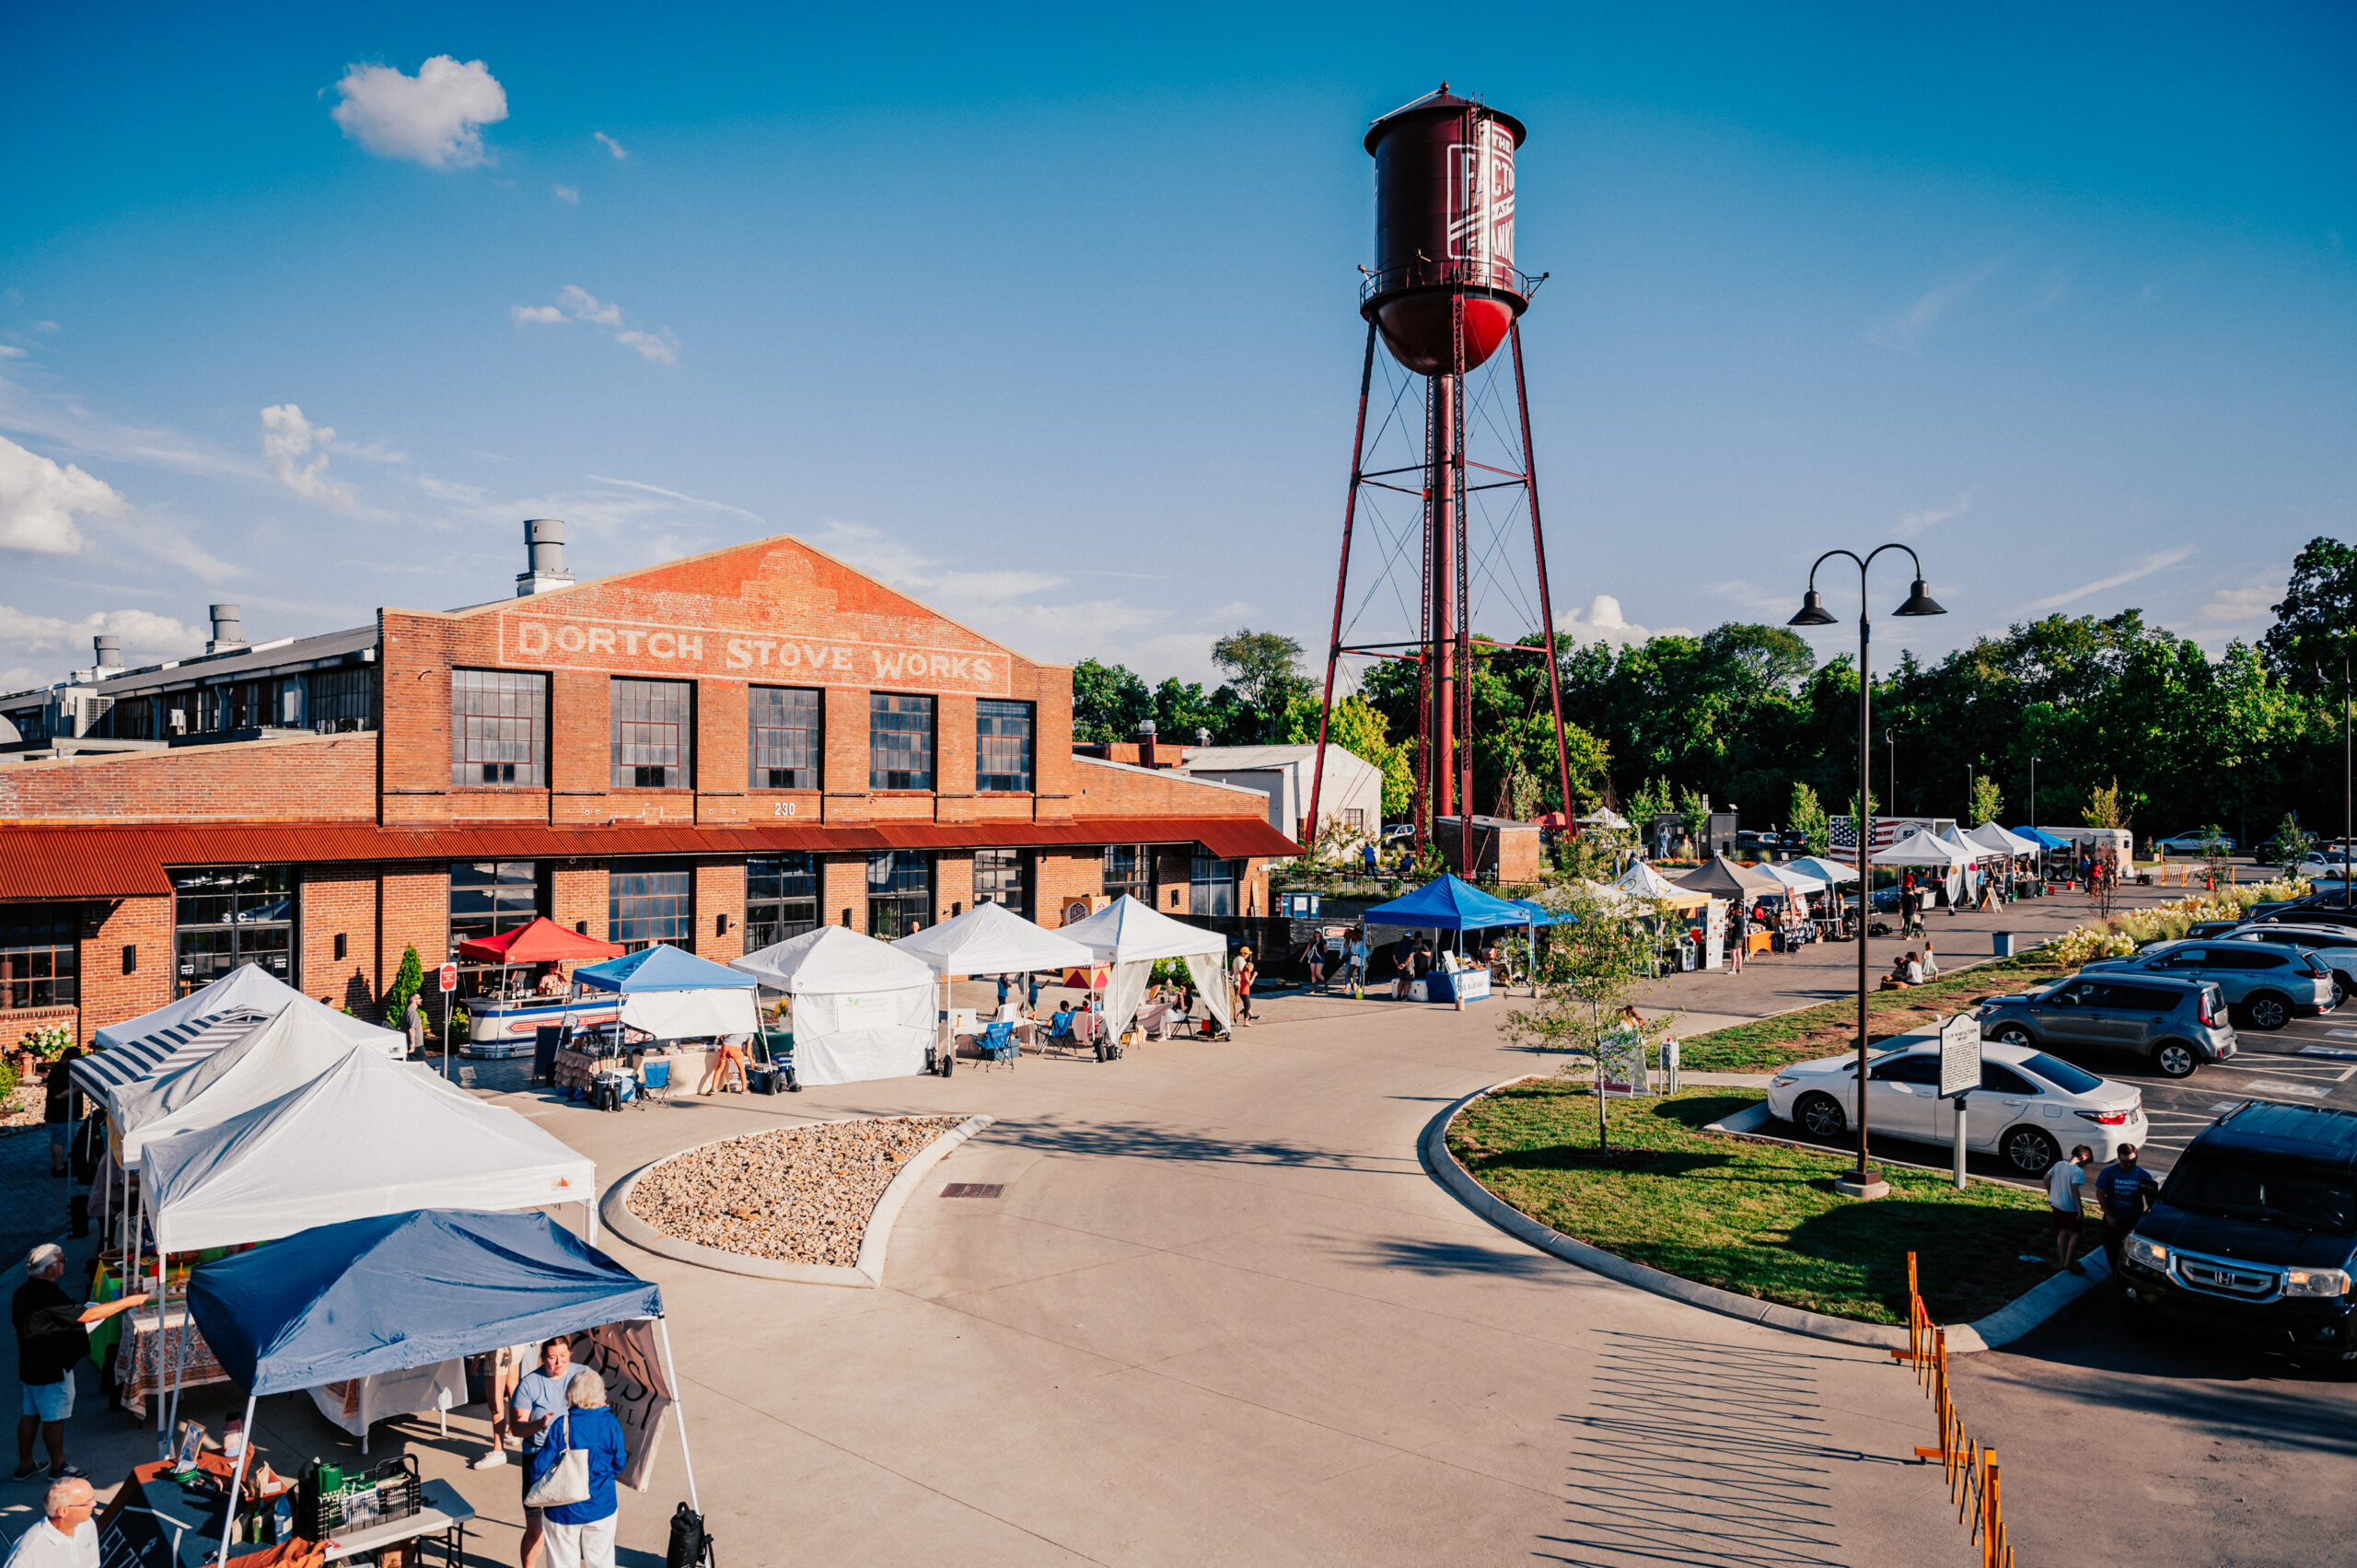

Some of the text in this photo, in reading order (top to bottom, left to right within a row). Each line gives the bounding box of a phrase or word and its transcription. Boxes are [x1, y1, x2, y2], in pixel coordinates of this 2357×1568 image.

[1492, 134, 1511, 155] THE
[1497, 203, 1508, 215] AT
[518, 621, 993, 682] DORTCH STOVE WORKS
[774, 802, 795, 816] 230
